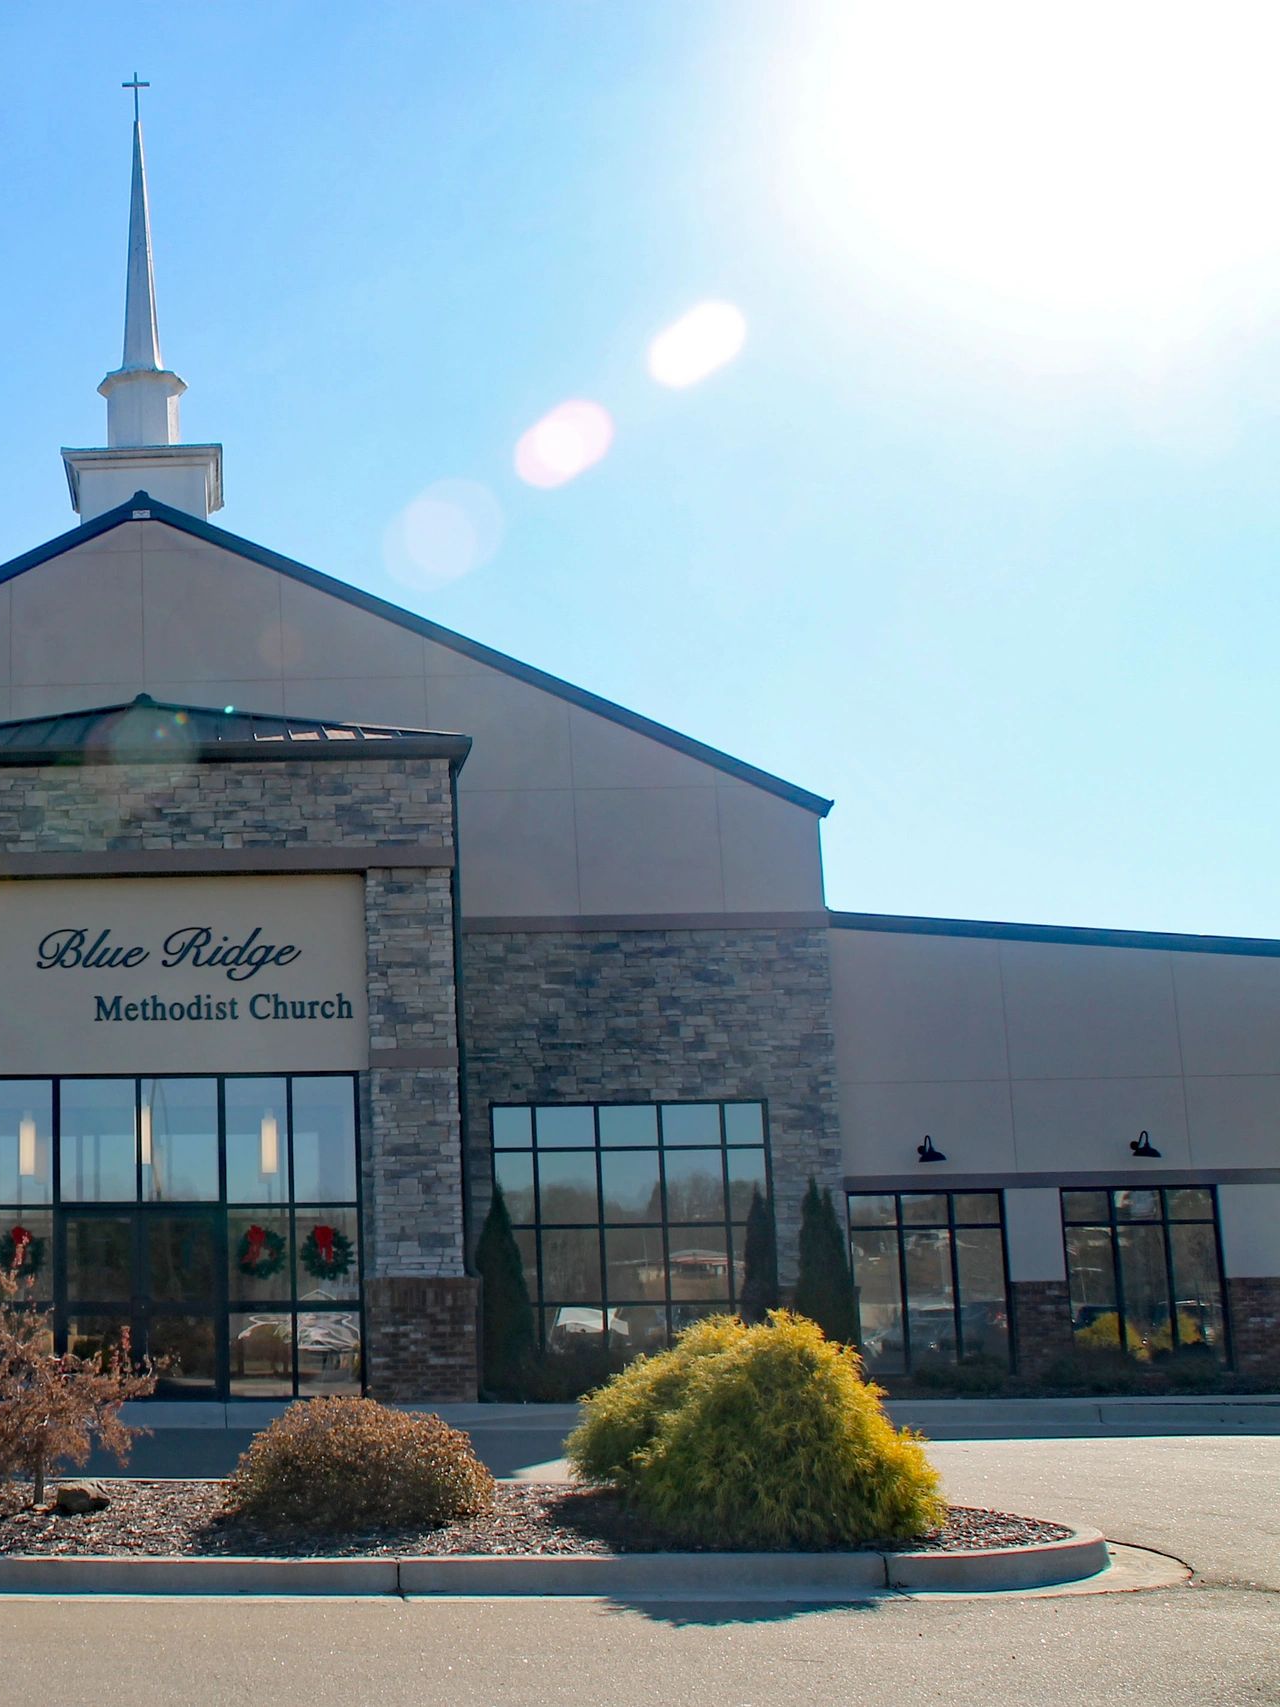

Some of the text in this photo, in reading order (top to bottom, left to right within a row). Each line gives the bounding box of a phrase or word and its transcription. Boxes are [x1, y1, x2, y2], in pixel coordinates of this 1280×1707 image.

[36, 926, 303, 982] Blue Ridge
[93, 993, 354, 1022] Methodist Church
